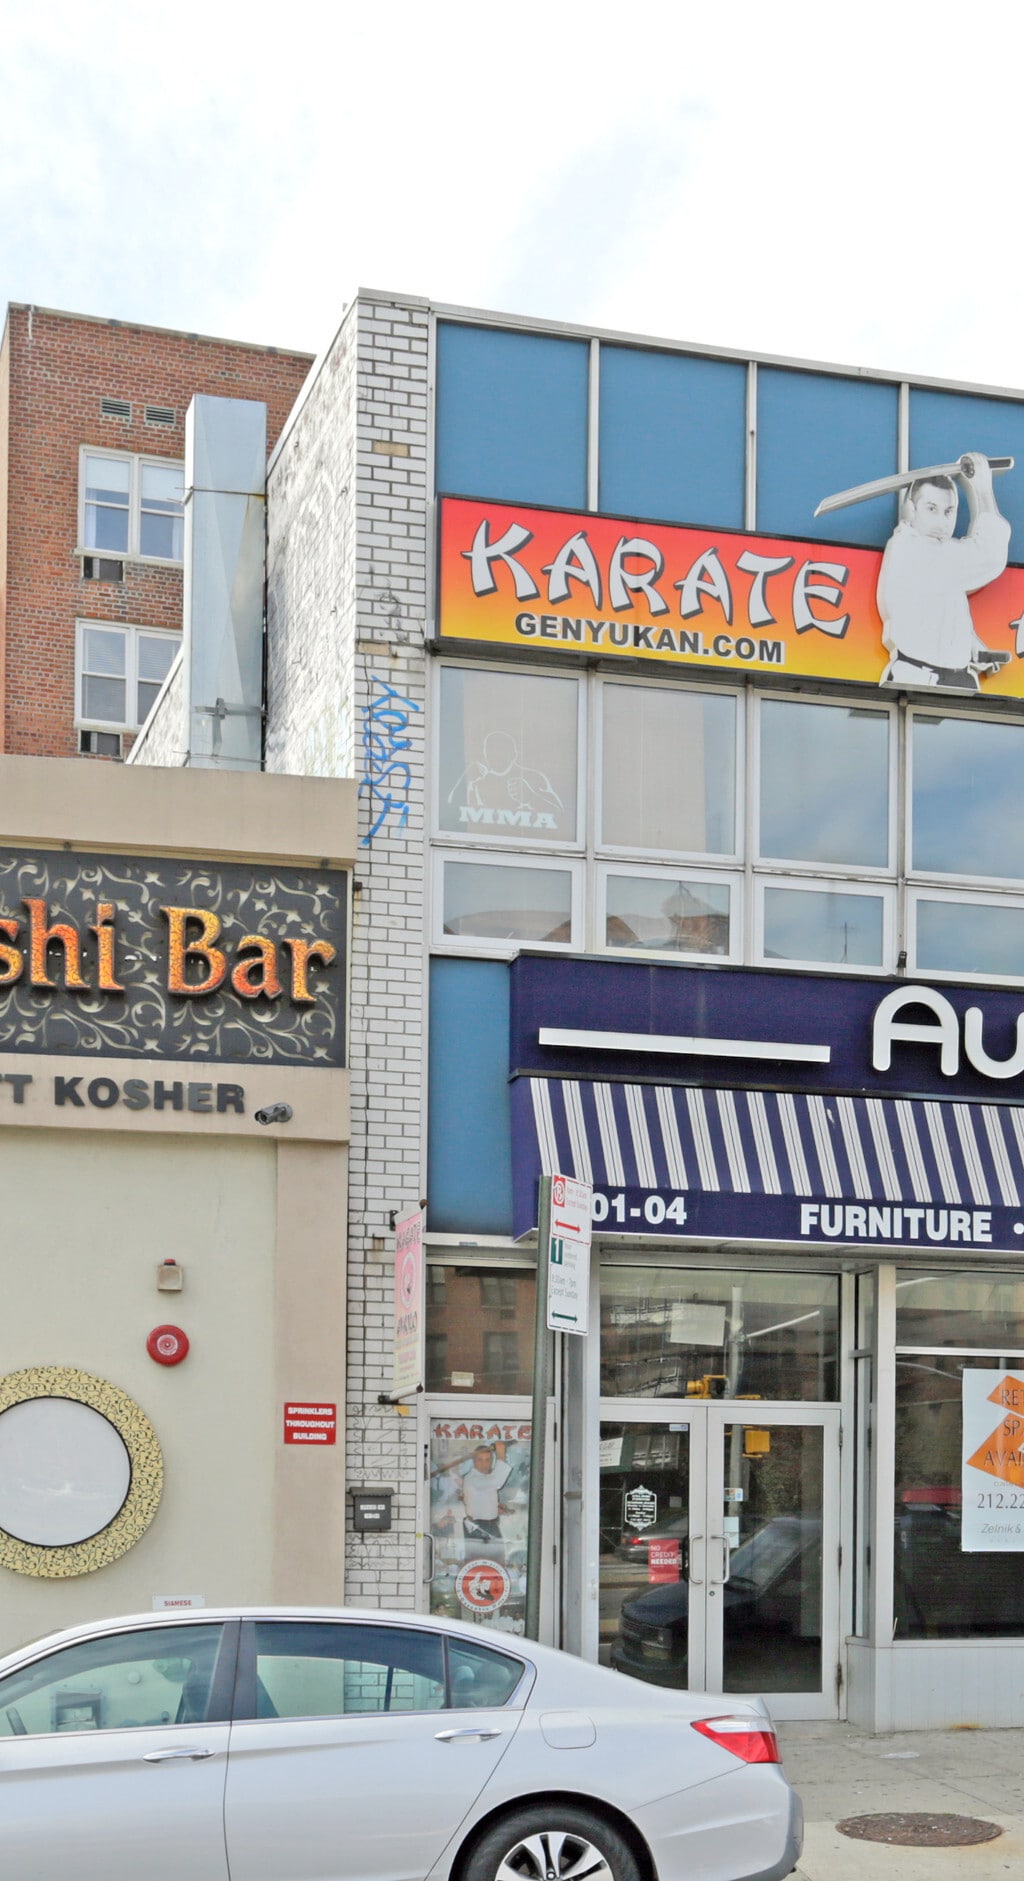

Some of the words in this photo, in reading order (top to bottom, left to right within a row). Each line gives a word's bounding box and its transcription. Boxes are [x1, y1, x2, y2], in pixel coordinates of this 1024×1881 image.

[461, 520, 849, 639] KARATE
[515, 612, 784, 664] GENYUKAN.COM
[460, 806, 558, 829] MMA
[161, 904, 338, 1003] Bar
[54, 1075, 245, 1114] KOSHER
[801, 1203, 993, 1243] FURNITURE
[287, 1406, 334, 1416] SPRINKLERS
[285, 1420, 335, 1429] THROUGHOUT
[433, 1423, 532, 1439] KARATE
[293, 1432, 327, 1441] BUILDING
[981, 1523, 1013, 1534] Zelnik
